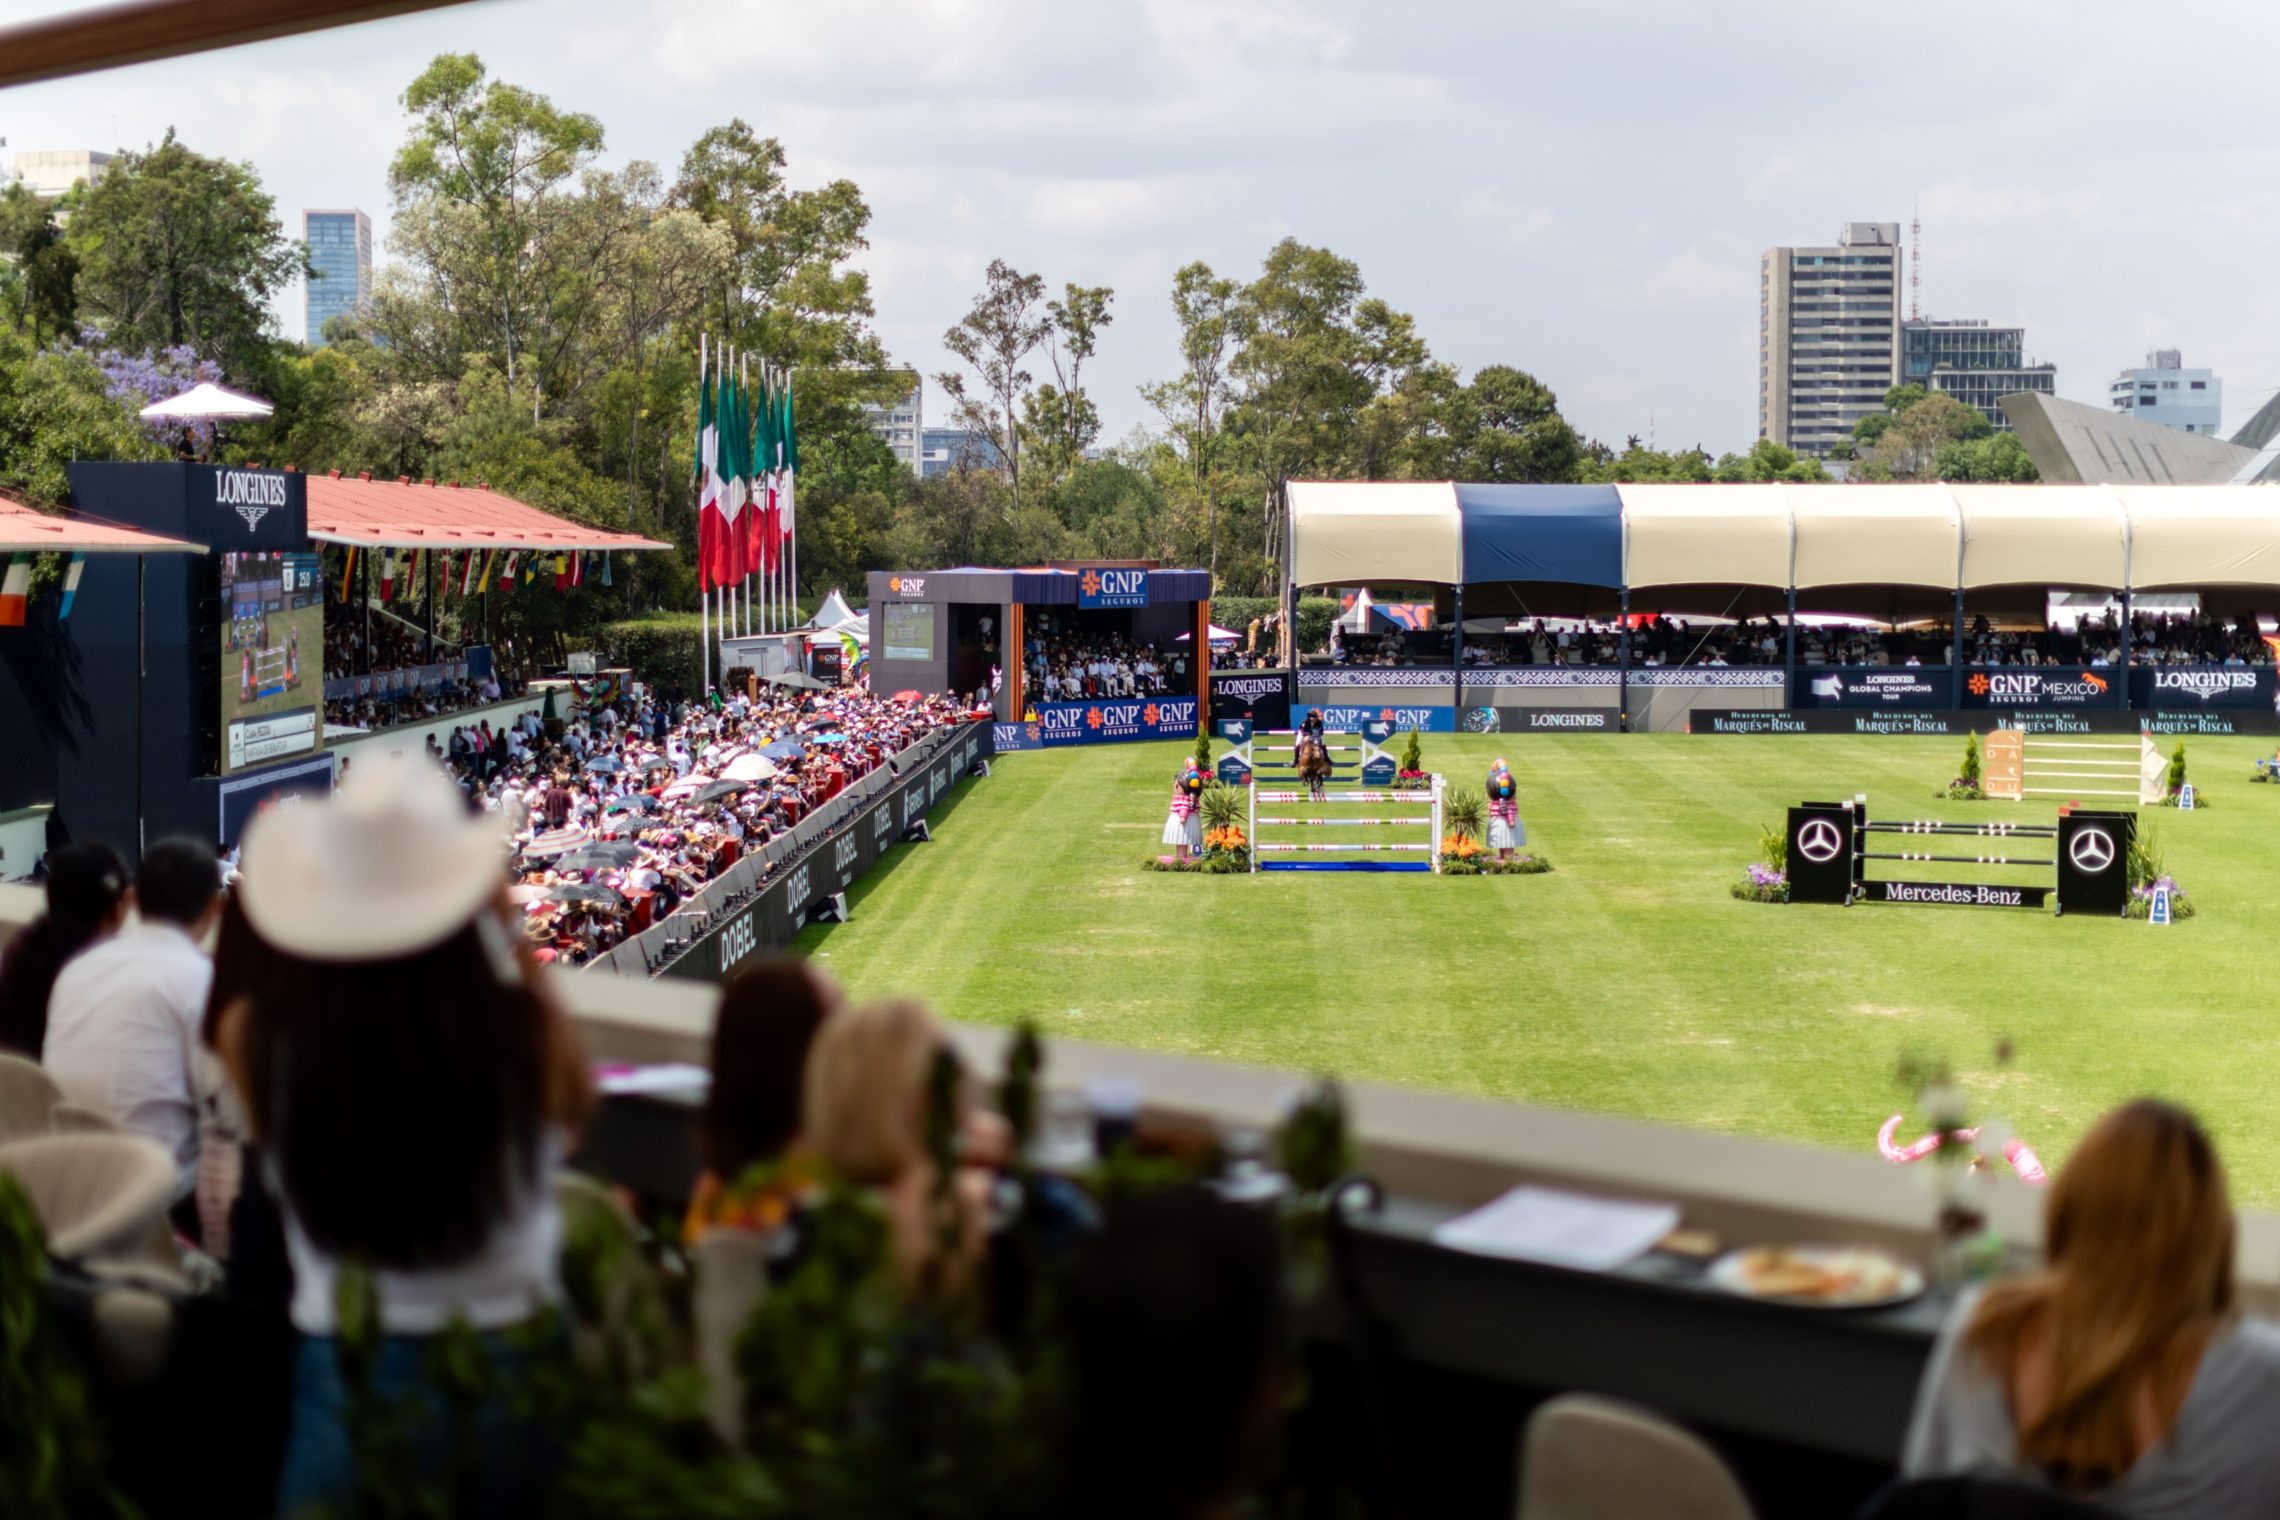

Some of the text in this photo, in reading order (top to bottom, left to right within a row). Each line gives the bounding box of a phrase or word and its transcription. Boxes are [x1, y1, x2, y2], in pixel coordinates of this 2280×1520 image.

[216, 471, 286, 506] LONGINES
[900, 579, 924, 592] GNP
[1101, 571, 1143, 594] GNP
[1101, 598, 1144, 606] SEGUROS
[1218, 678, 1282, 695] LONGINES
[1866, 675, 1915, 684] LONGINES
[1990, 675, 2038, 694] GNP
[2155, 672, 2257, 688] LONGINES
[1849, 685, 1881, 693] GLOBAL
[2042, 682, 2099, 695] MEXICO
[1044, 708, 1081, 729] GNP
[1104, 706, 1138, 726] GNP
[1160, 702, 1194, 722] GNP
[1324, 709, 1357, 724] GNP
[1395, 710, 1429, 724] GNP
[1160, 724, 1194, 732] SEGUROS
[1530, 714, 1604, 727] LONGINES
[1714, 718, 1762, 734] MARQUÉS
[1771, 718, 1807, 732] RISCAL
[1856, 718, 1904, 733] MARQUÉS
[1913, 718, 1948, 732] RISCAL
[2056, 718, 2091, 732] RISCAL
[2198, 718, 2234, 732] RISCAL
[1044, 730, 1082, 739] SEGUROS
[1103, 727, 1138, 736] SEGUROS
[874, 801, 892, 839] DOBEL
[836, 830, 858, 872] DOBEL
[787, 863, 811, 914] DOBEL
[1886, 883, 2022, 905] Mercedes-Benz
[721, 911, 758, 973] DOBEL
